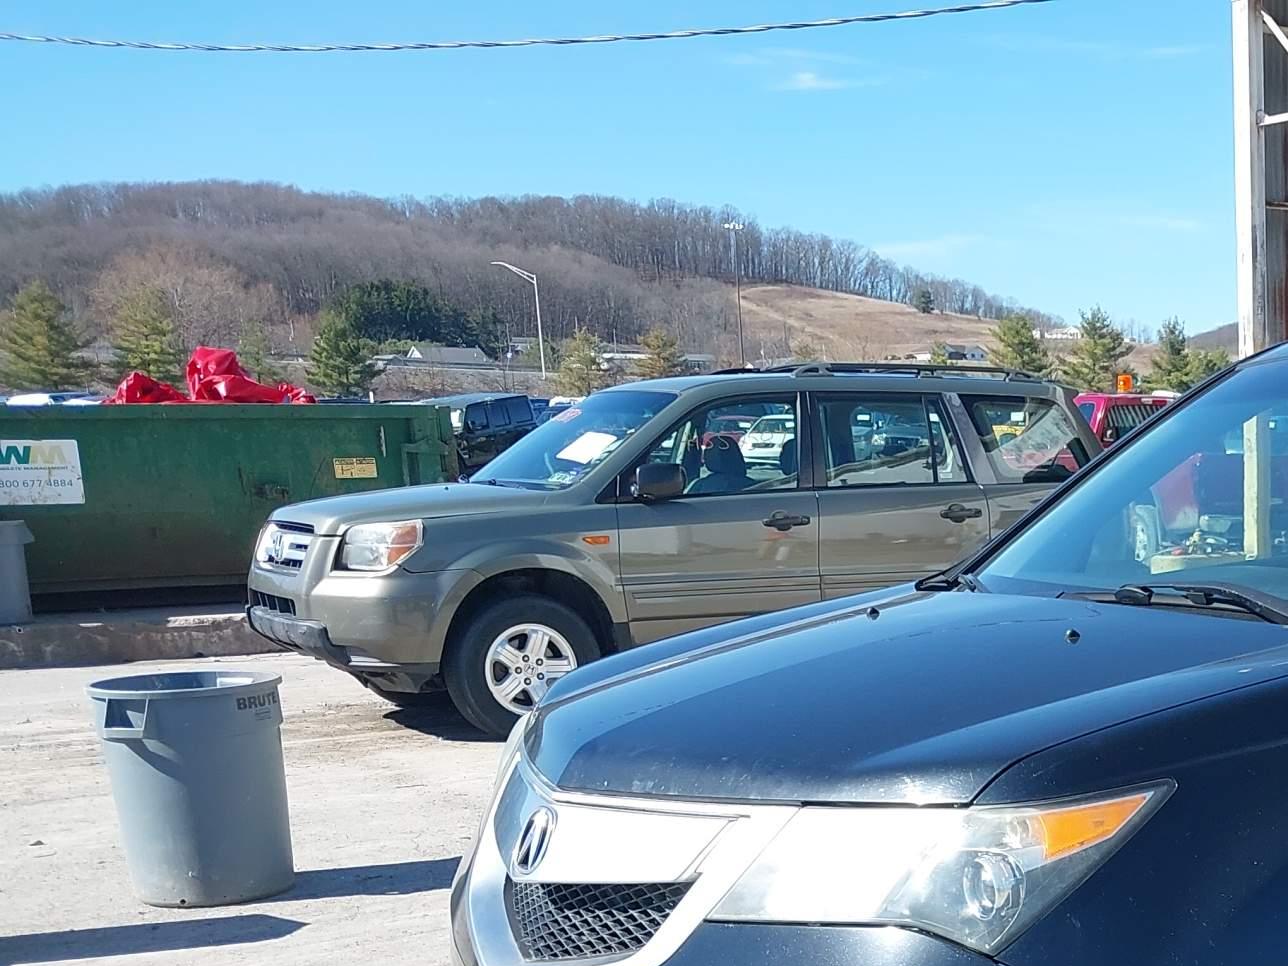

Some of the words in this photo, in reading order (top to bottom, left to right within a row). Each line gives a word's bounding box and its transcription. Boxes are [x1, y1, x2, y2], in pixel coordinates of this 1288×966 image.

[22, 479, 42, 488] 677
[46, 479, 73, 488] 4884
[236, 691, 278, 710] BRUTE
